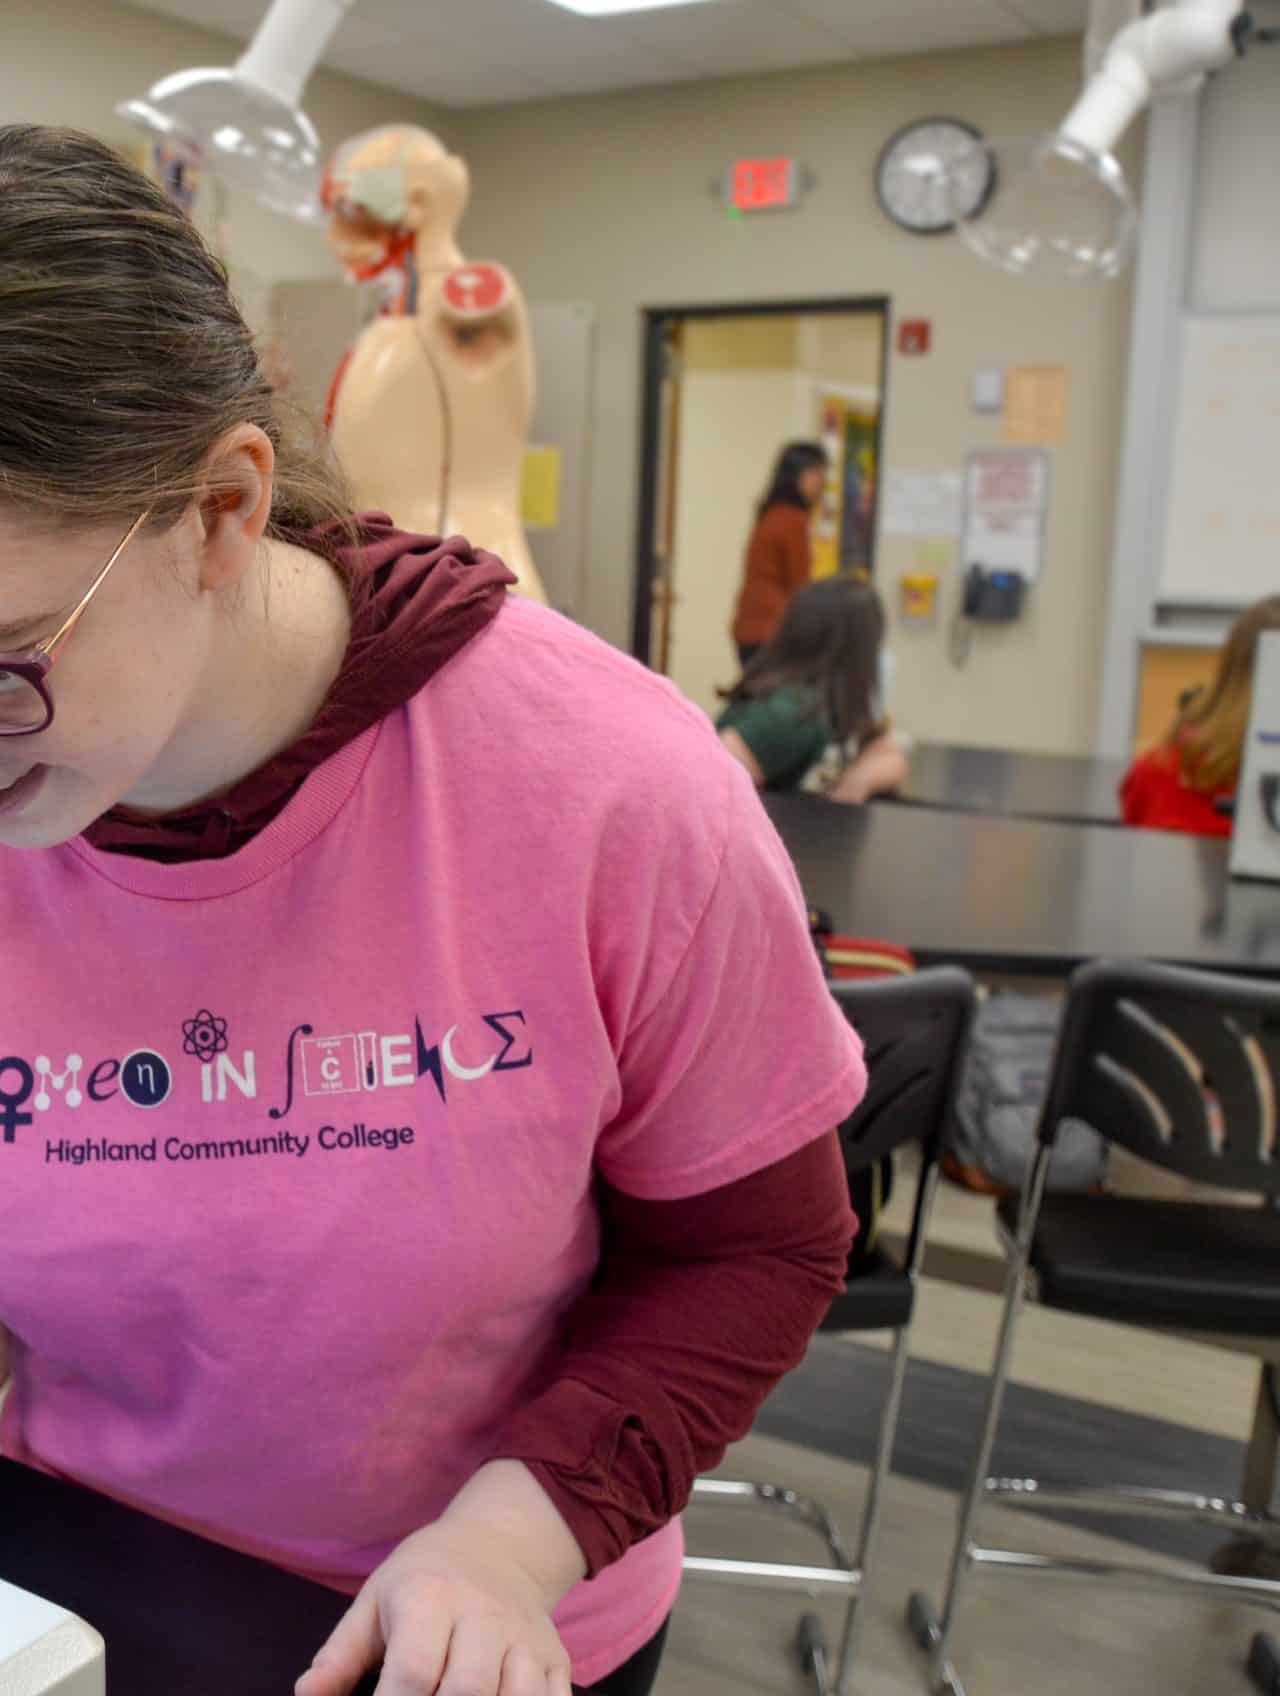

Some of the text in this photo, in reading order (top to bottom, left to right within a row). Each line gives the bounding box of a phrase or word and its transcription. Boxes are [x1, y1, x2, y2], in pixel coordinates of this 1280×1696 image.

[200, 1050, 257, 1102] IN
[44, 1123, 415, 1165] Highland Community College
